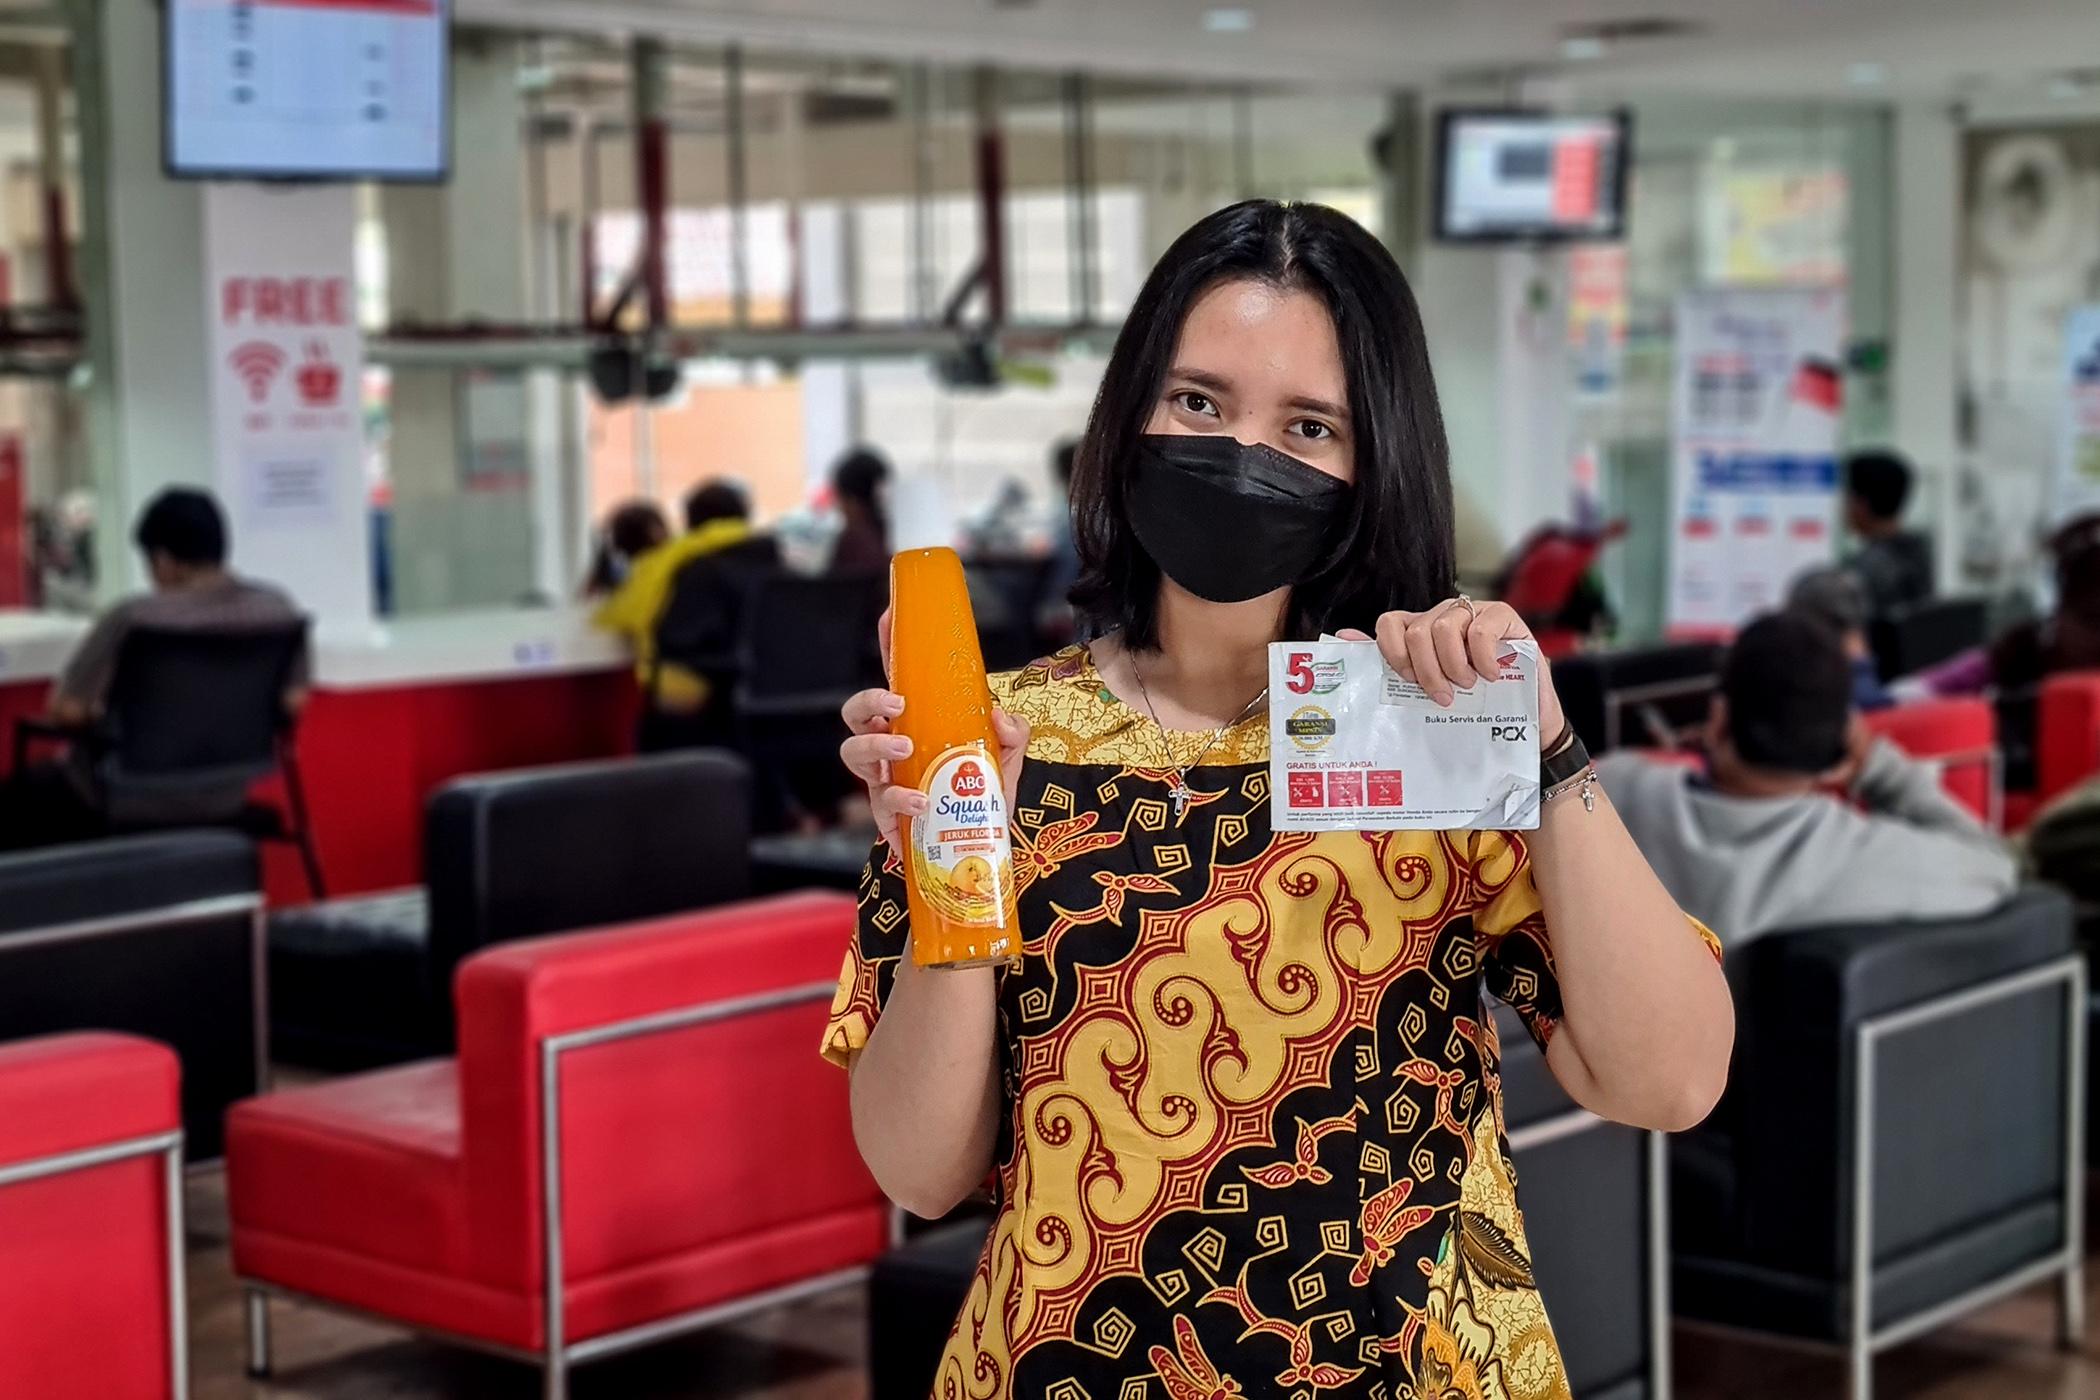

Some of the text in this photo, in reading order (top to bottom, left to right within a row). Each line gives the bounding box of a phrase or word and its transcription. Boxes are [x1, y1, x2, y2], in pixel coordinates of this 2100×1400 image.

[222, 276, 347, 325] FREE
[1285, 653, 1314, 694] 5
[1425, 714, 1527, 723] Buku Servis dan Garansi
[1491, 726, 1527, 741] PCX
[1319, 761, 1347, 769] UNTUK
[955, 776, 985, 790] ABC
[960, 814, 990, 826] Deligh
[944, 828, 1000, 841] JERUK FLORA
